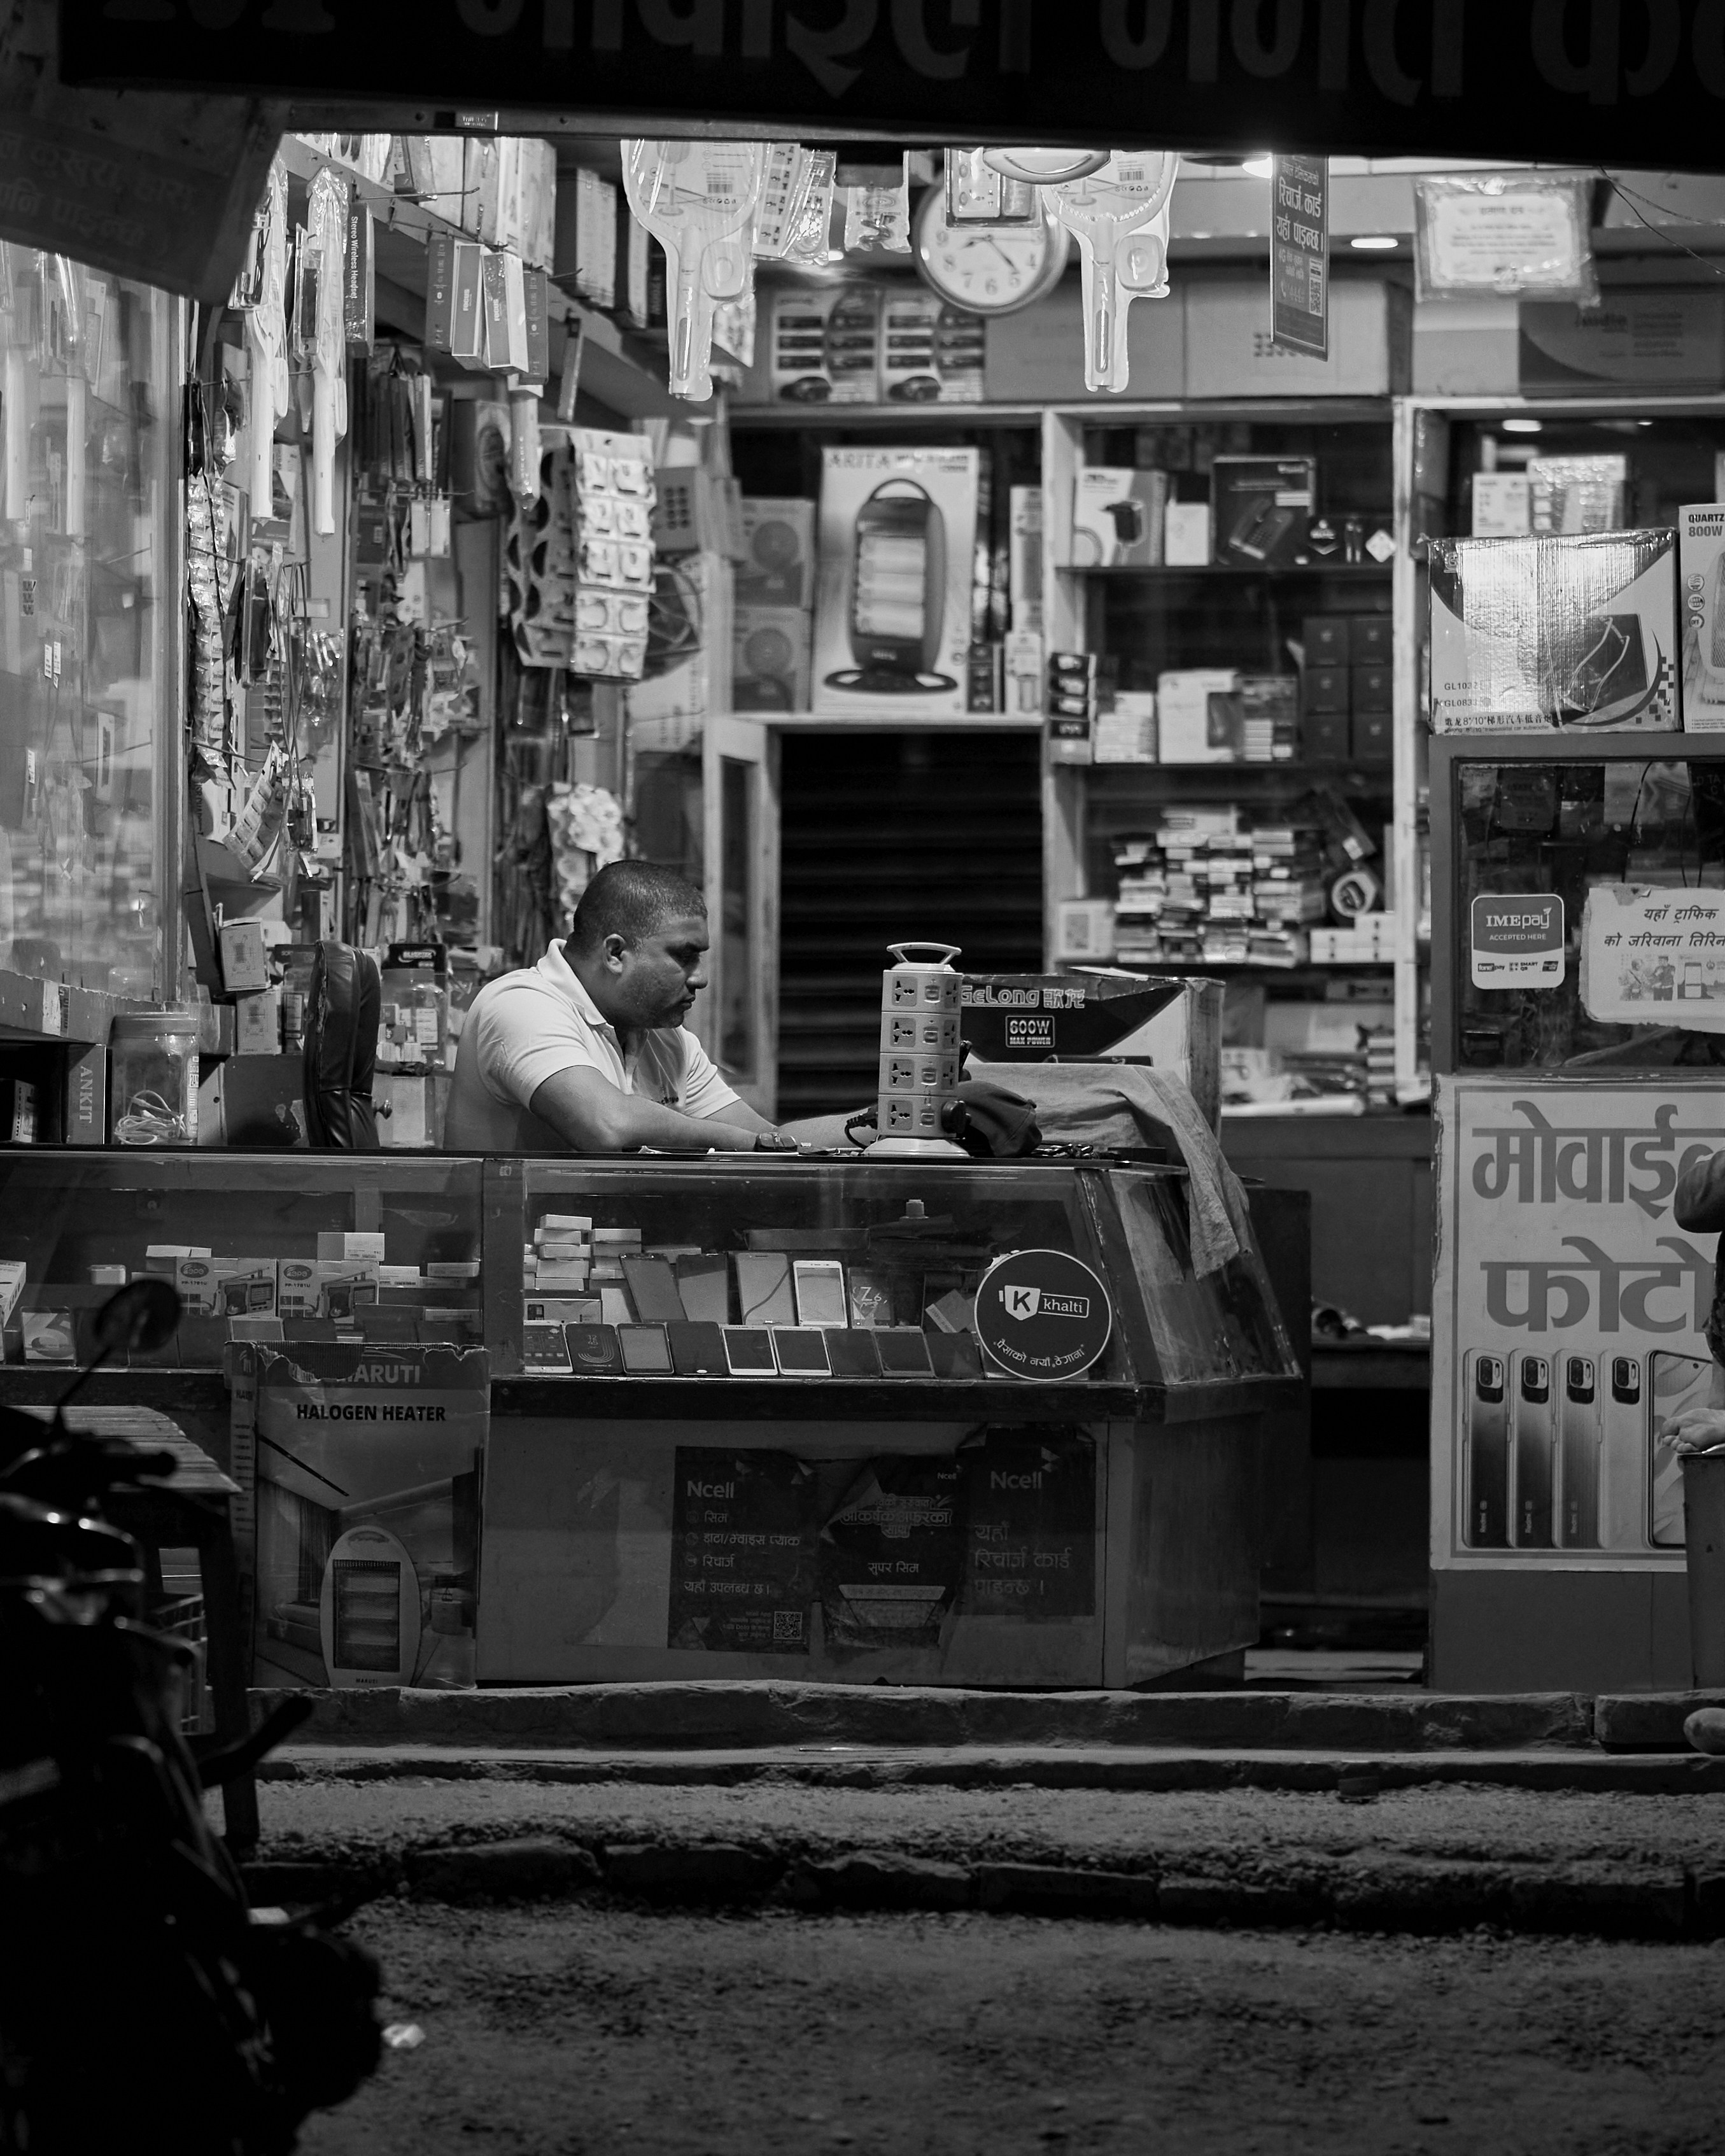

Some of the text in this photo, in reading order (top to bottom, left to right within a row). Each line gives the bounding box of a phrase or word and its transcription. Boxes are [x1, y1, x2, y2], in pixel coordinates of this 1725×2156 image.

[1279, 176, 1321, 218] रिचार्ज कार्ड
[351, 239, 359, 269] Wireless
[1688, 514, 1725, 523] QUARTZ
[1688, 526, 1722, 537] 800W
[1644, 904, 1719, 924] यहाँ ट्राफिक
[1604, 931, 1623, 947] को
[1628, 931, 1684, 947] जरिवाना
[1009, 1020, 1050, 1034] 600W
[1010, 1036, 1051, 1045] MAX POWER
[79, 1065, 94, 1124] ANKIT
[1013, 1290, 1083, 1314] K khalti
[996, 1338, 1027, 1363] पैसाको
[1053, 1348, 1085, 1366] ठेगाना
[347, 1364, 421, 1384] ARUTI
[297, 1404, 446, 1421] HALOGEN HEATER
[937, 1472, 957, 1481] Ncell
[990, 1470, 1042, 1490] Ncell
[686, 1480, 735, 1499] Ncell
[704, 1510, 728, 1524] सिम
[702, 1553, 735, 1568] रिचार्ज
[1032, 1547, 1073, 1569] कार्ड
[868, 1561, 920, 1576] सुपर सिम
